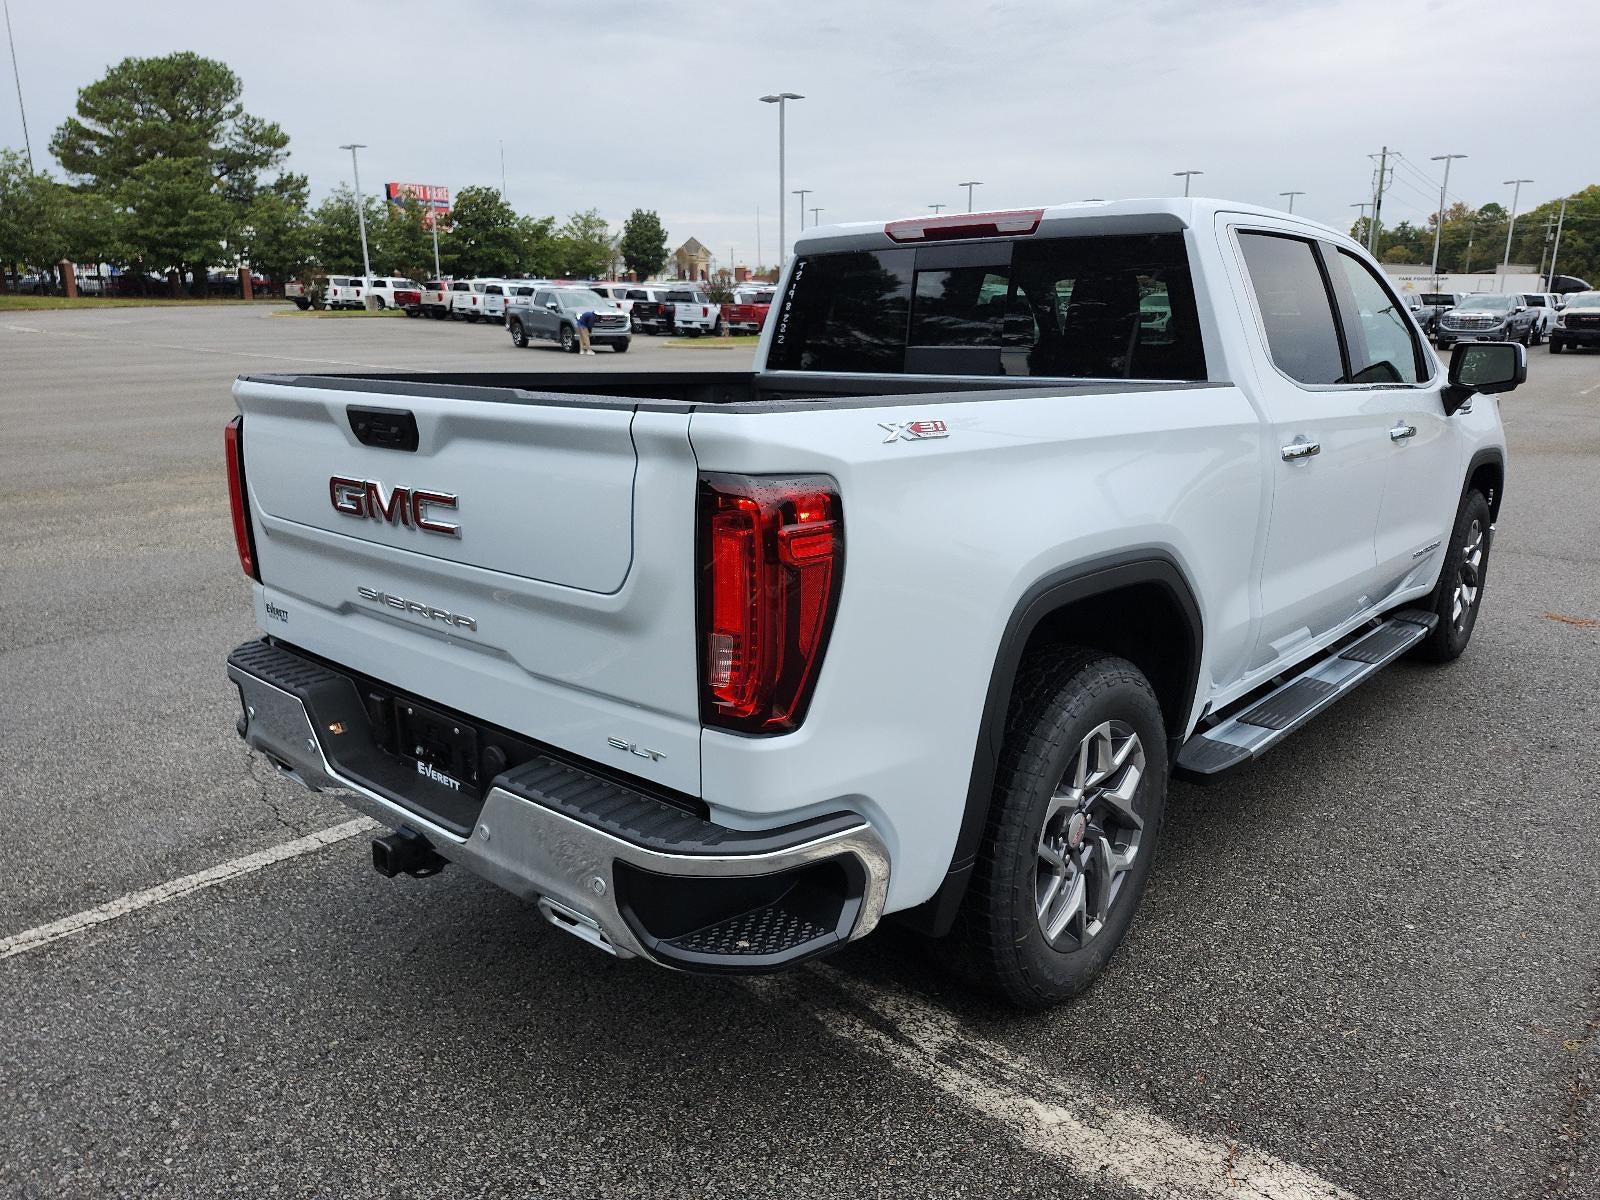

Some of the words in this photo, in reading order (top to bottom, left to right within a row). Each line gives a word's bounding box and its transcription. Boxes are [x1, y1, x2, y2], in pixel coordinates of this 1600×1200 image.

[329, 474, 462, 540] GMC
[357, 585, 477, 631] SIERRA
[607, 736, 667, 762] SLT
[417, 760, 461, 791] EVERETT
